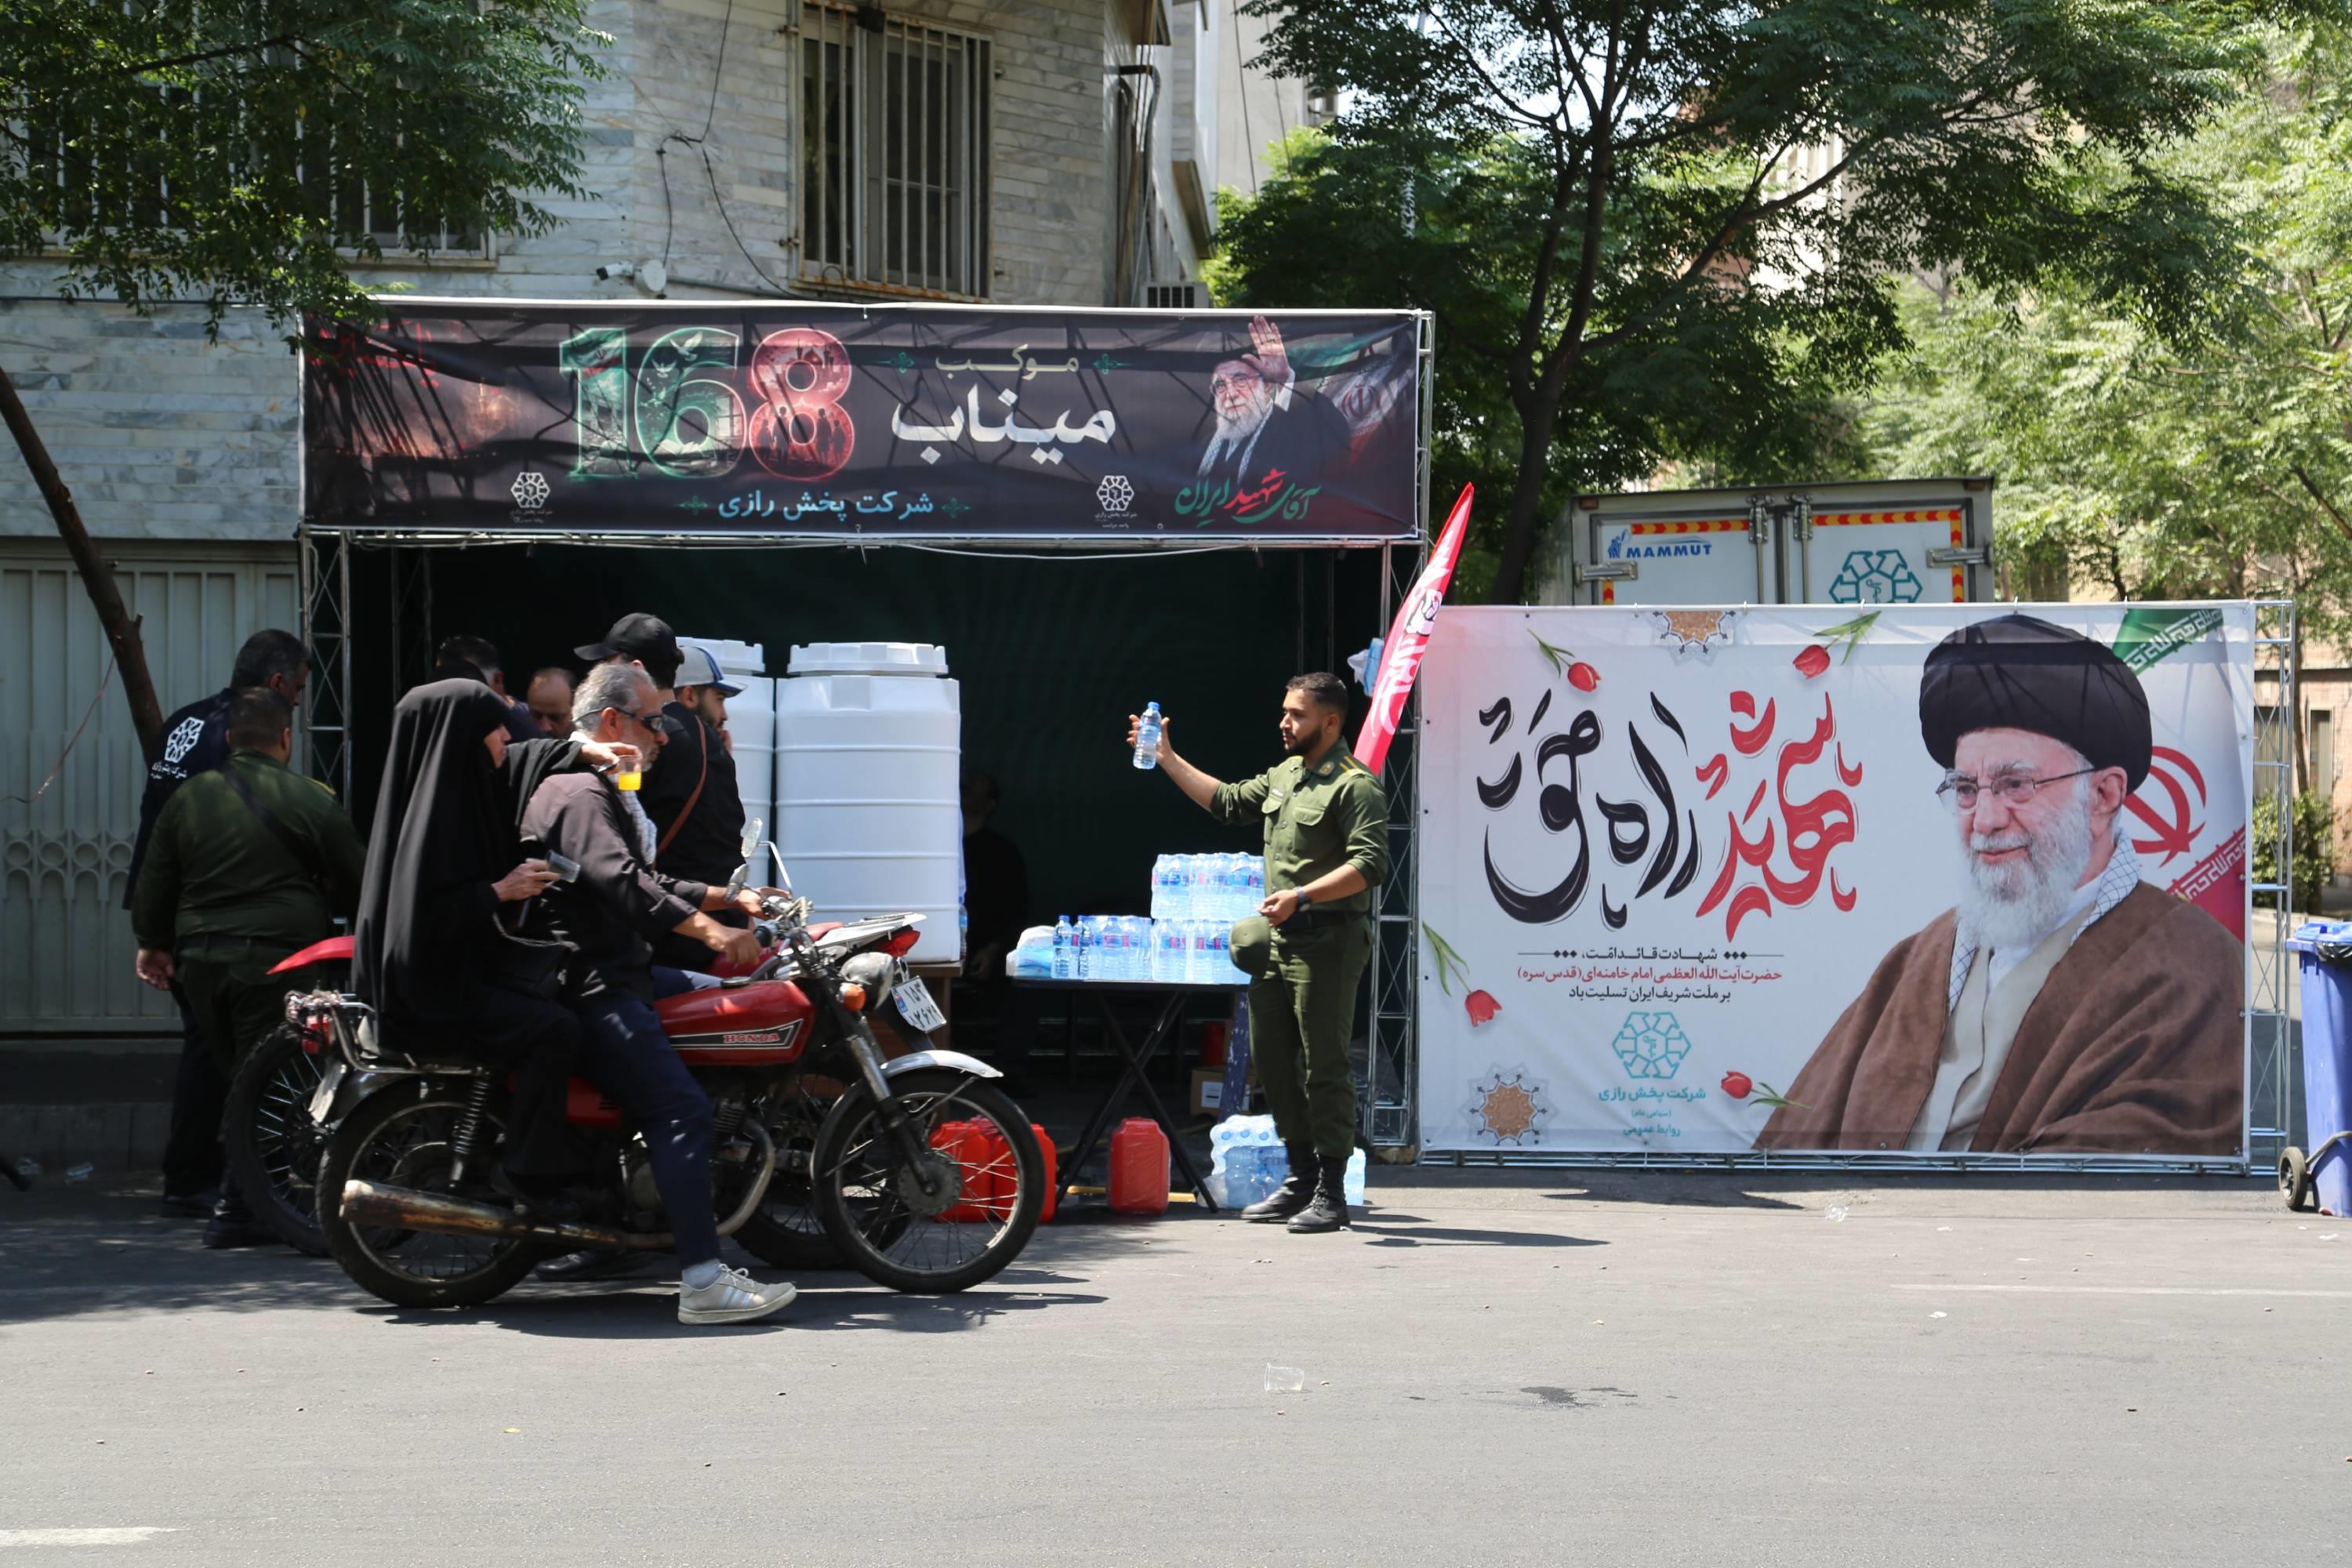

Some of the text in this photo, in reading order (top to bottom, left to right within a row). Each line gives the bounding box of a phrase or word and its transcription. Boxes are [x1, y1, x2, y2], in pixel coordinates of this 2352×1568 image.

[935, 343, 1079, 380] موکب
[559, 326, 855, 480] 168
[891, 383, 1116, 465] میناب
[1223, 468, 1287, 515] شهید
[718, 489, 934, 522] شرکت پخش رازی
[1174, 477, 1231, 529] ایران
[1626, 544, 1711, 558] MAMMUT
[1696, 691, 1863, 942] شهید
[1658, 947, 1718, 964] شهادت
[1631, 967, 1653, 984] امام
[1653, 967, 1697, 984] العظمی
[1719, 965, 1741, 983] آیت
[1741, 967, 1782, 984] حضرت
[1569, 985, 1584, 1002] باد
[1585, 986, 1628, 1001] تسلیت
[1628, 985, 1655, 1003] ایران
[1655, 986, 1691, 1003] شریف
[1719, 990, 1731, 1004] بر
[724, 1033, 780, 1044] HONDA
[1598, 1087, 1707, 1104] شرکت پخش رازی
[1623, 1123, 1682, 1138] روابط عمومی
